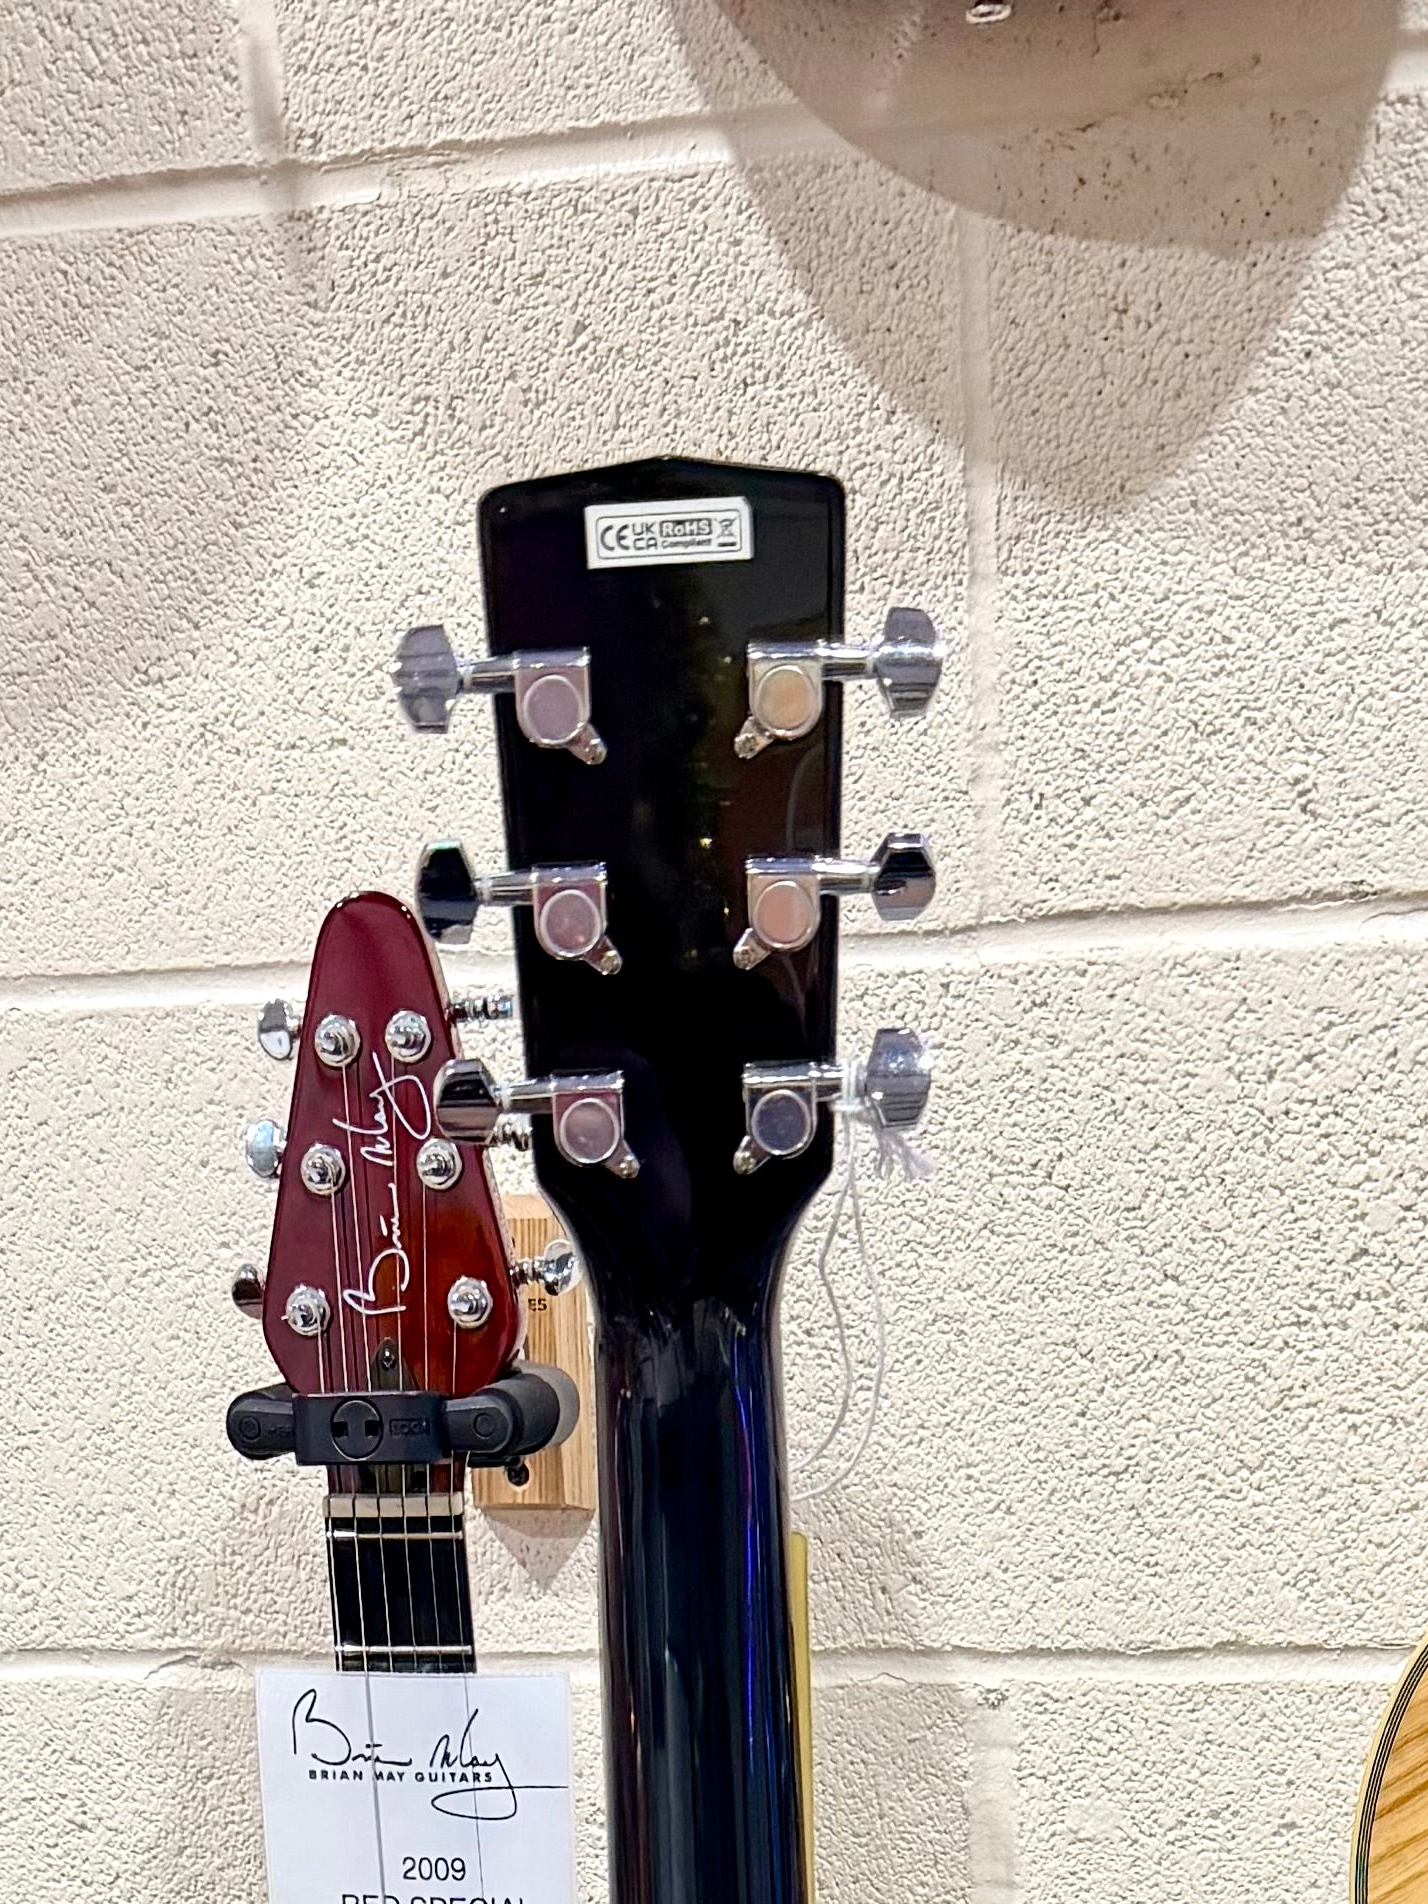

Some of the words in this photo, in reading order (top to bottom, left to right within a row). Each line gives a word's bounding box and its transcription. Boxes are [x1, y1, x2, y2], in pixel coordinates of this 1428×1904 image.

[632, 522, 656, 536] UK
[660, 519, 712, 537] RoHS
[633, 537, 658, 551] CA
[309, 1770, 363, 1781] BRIAN
[373, 1771, 404, 1782] MAY
[415, 1771, 492, 1783] GUITARS
[402, 1856, 466, 1882] 2009
